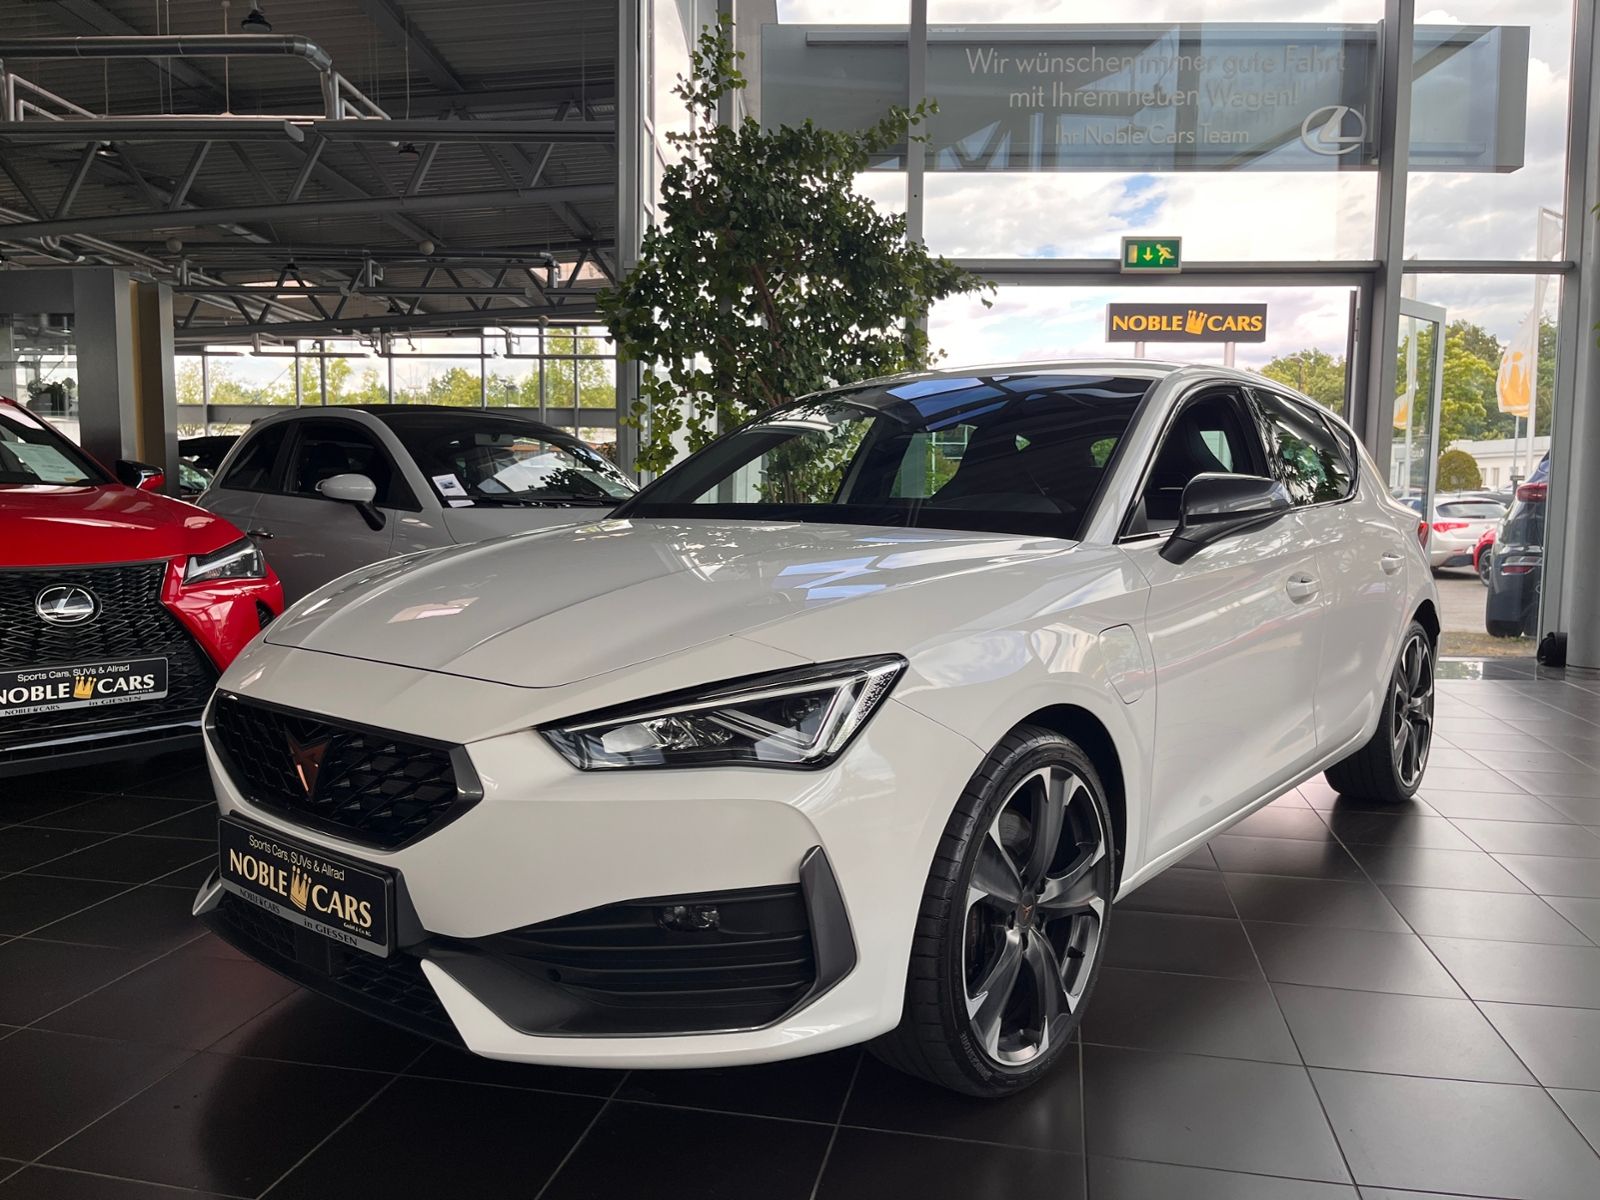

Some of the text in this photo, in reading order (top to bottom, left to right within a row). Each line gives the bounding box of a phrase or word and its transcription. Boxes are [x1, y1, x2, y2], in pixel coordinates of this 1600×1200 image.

[965, 45, 1346, 79] Wir wünschen immer gute Fahrt
[1009, 80, 1299, 112] mit Ihrem neuen Wagen!
[1055, 122, 1249, 144] Ihr Noble Cars Team
[1112, 315, 1263, 332] NOBLE CARS
[17, 664, 130, 683] Sports Cars, SUVs & Allrad
[97, 674, 155, 693] CARS
[248, 834, 345, 881] Sports Cars, SUVs & Allrad
[229, 848, 372, 928] NOBLE CARS
[304, 918, 312, 929] in
[315, 923, 358, 946] GIESSEN
